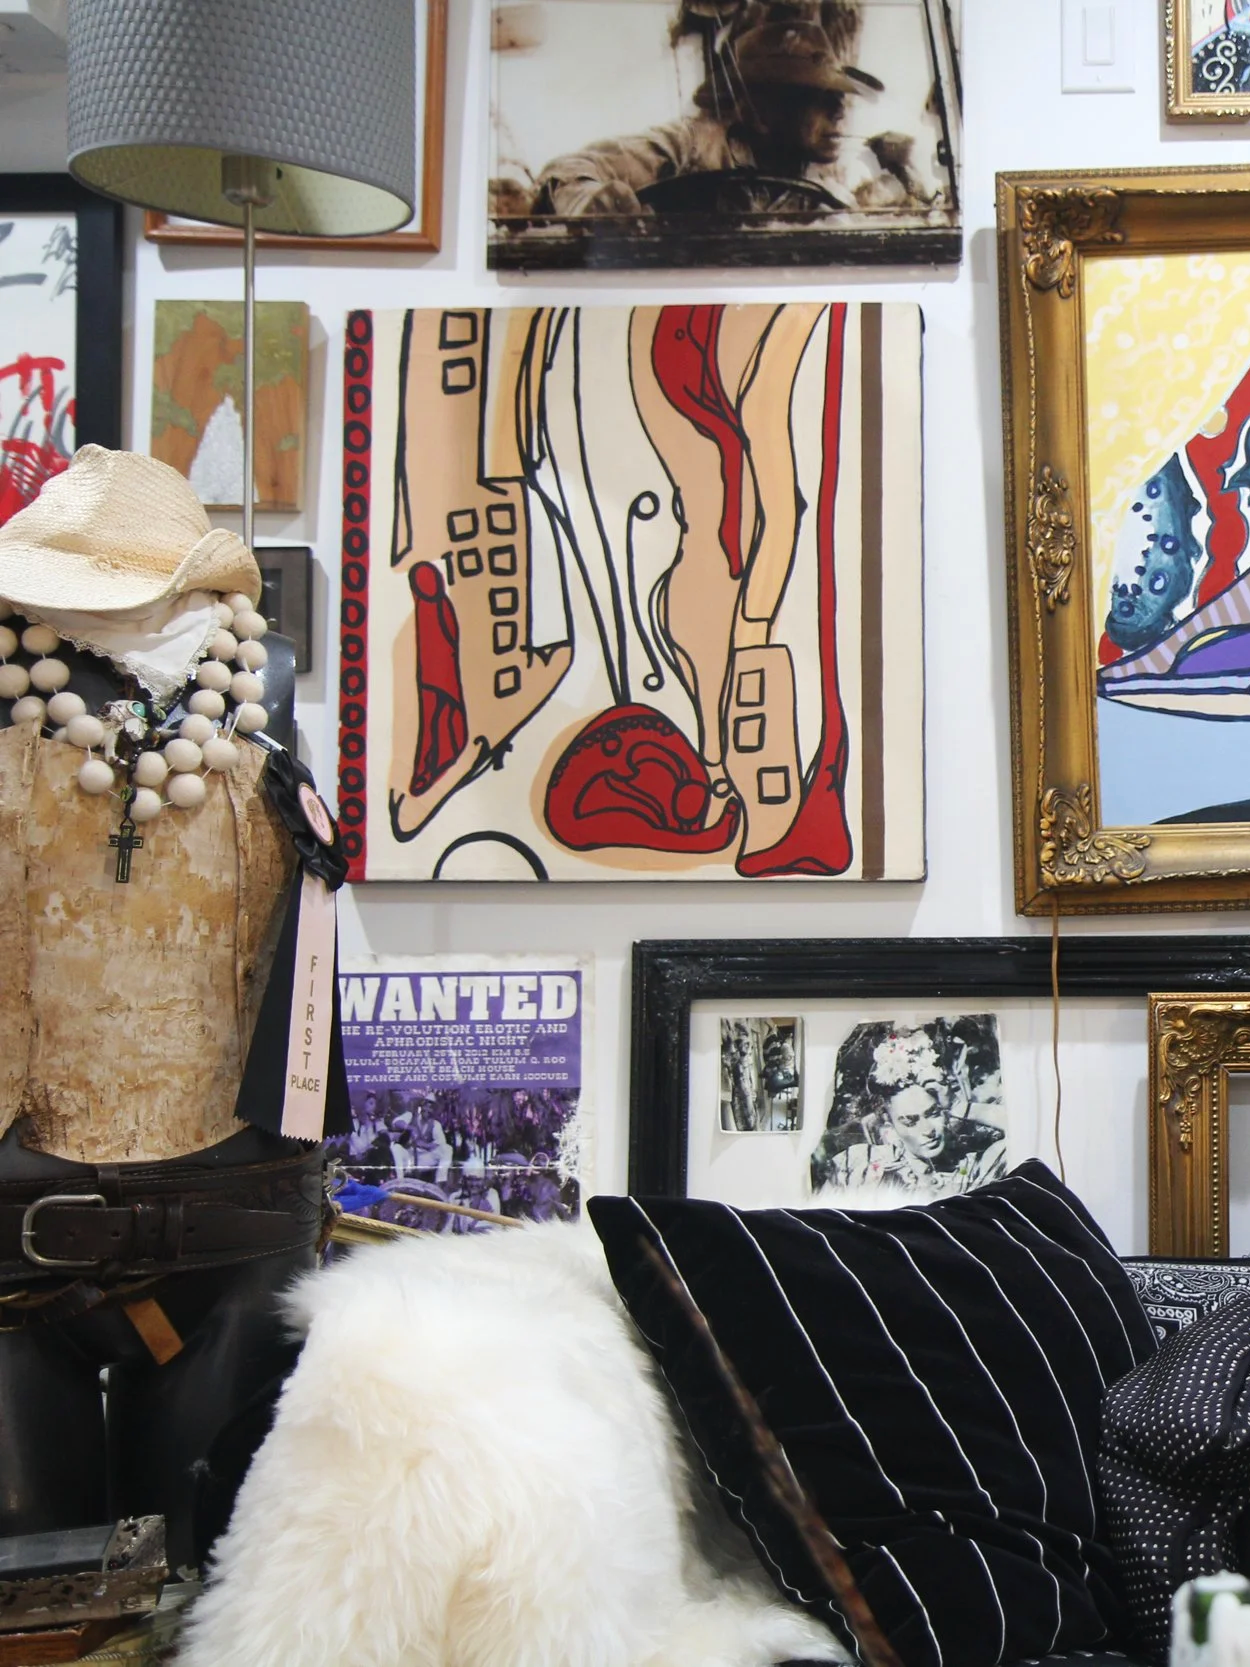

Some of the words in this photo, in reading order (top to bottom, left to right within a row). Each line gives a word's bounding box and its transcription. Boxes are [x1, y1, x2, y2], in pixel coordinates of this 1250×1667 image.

[338, 975, 578, 1023] WANTED
[302, 954, 319, 1071] FIRST
[341, 1025, 361, 1036] HE
[365, 1024, 471, 1035] RE-VOLUTION
[475, 1023, 531, 1034] EROTIC
[535, 1023, 568, 1034] AND
[374, 1036, 475, 1047] APHRODISIAC
[479, 1035, 528, 1046] NIGHT
[371, 1049, 431, 1058] FEBRUARY
[344, 1057, 446, 1067] ULUM-BOCAPAILA
[483, 1056, 526, 1065] TULUM
[387, 1066, 436, 1074] PRIVATE
[290, 1074, 321, 1093] PLACE
[364, 1074, 401, 1083] DANCE
[404, 1073, 428, 1082] AND
